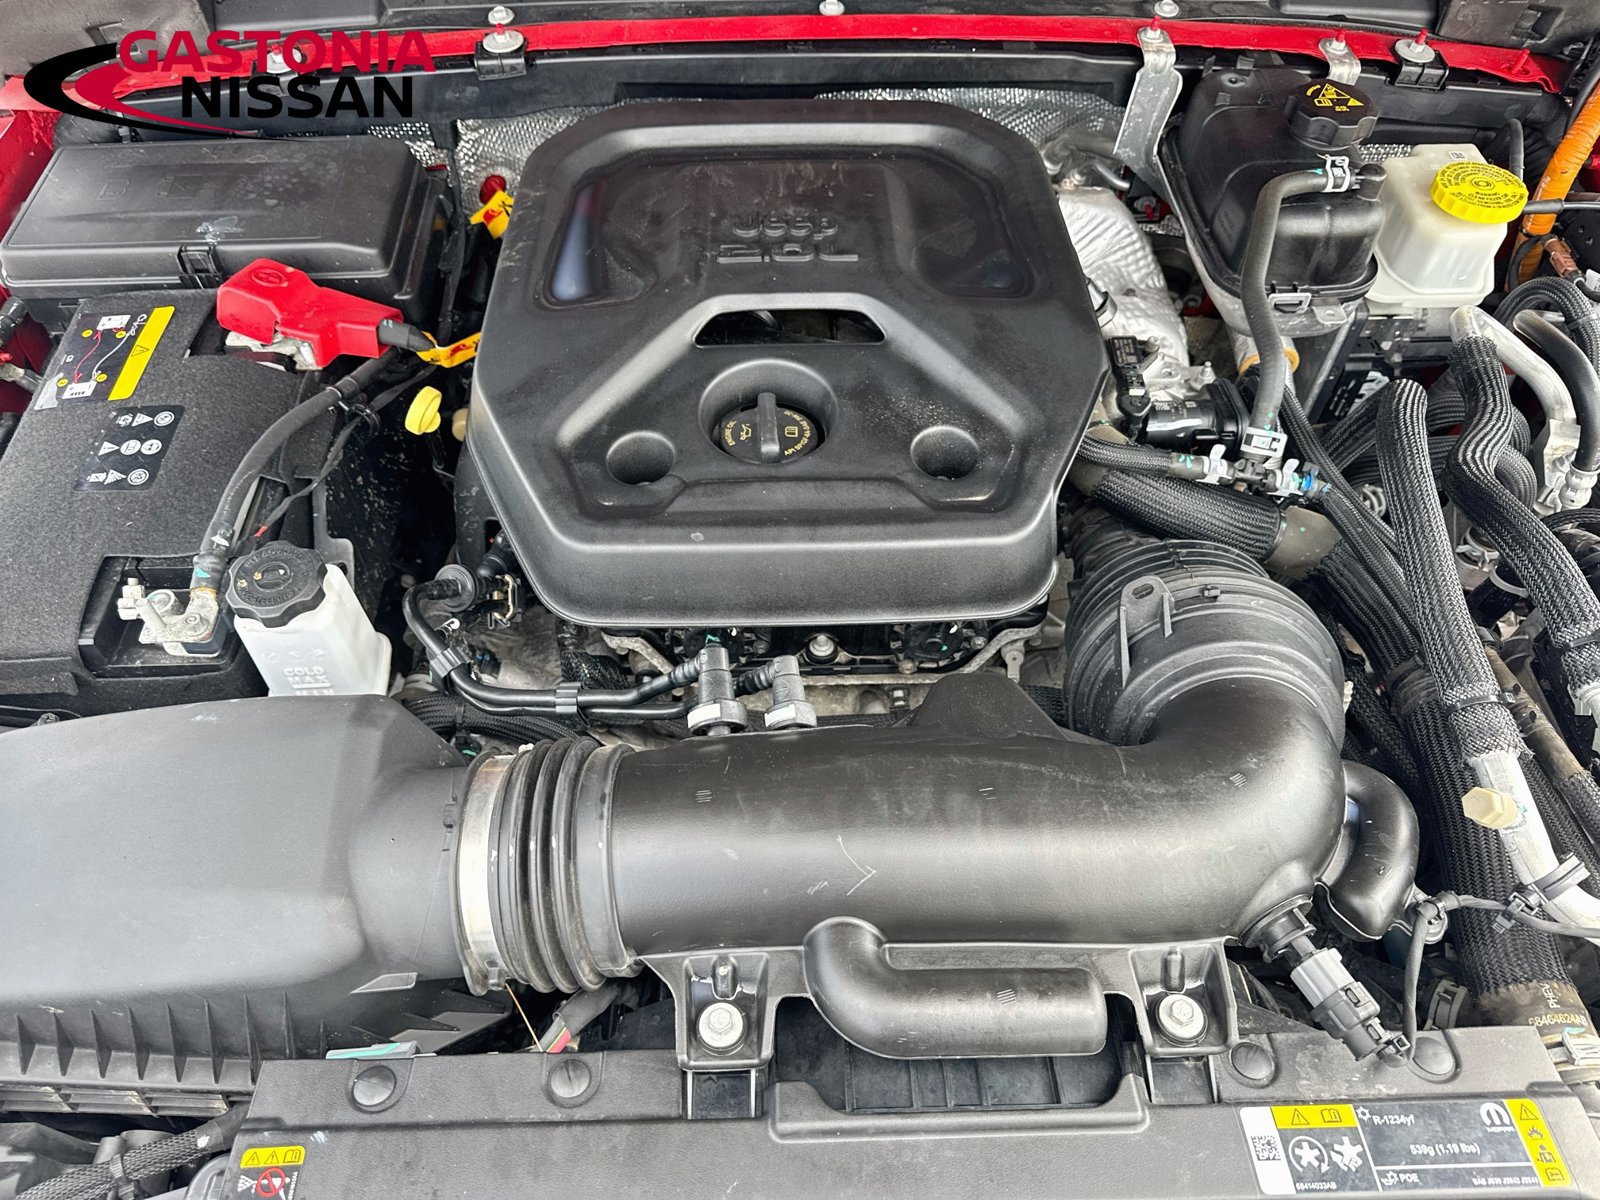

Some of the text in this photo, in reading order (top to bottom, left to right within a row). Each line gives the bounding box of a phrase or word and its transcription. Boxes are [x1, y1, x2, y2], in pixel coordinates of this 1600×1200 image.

[733, 213, 838, 239] Jeep
[716, 243, 859, 264] 2.0L
[284, 666, 324, 676] COLD
[287, 675, 331, 685] MAX
[1540, 982, 1561, 1009] PHEV
[1372, 1114, 1415, 1126] R-1234yf
[1409, 1143, 1480, 1156] 539g (1.19 lbs)
[1398, 1173, 1420, 1183] POE
